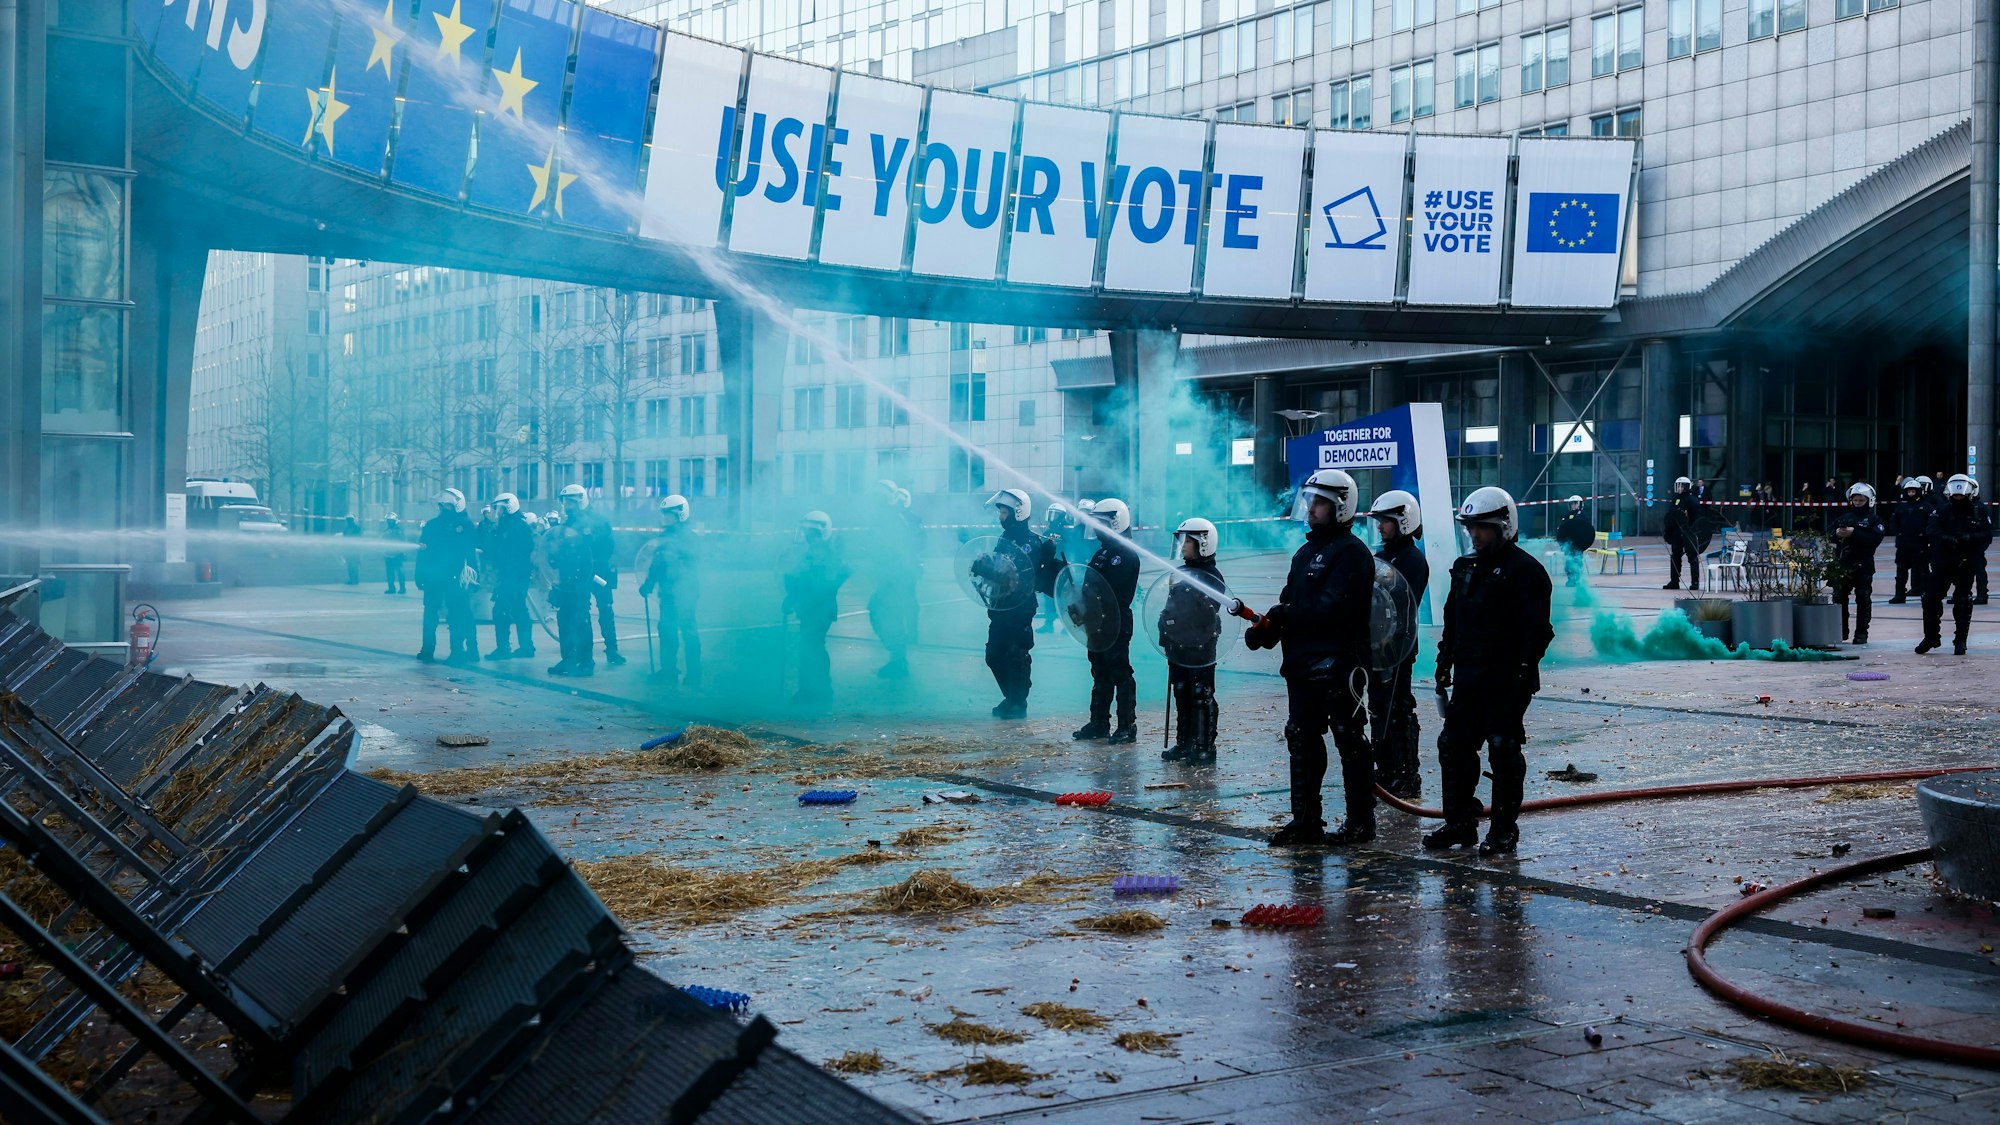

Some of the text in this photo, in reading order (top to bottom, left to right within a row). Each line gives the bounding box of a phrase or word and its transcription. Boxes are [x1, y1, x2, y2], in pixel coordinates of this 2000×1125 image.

[716, 106, 1263, 249] USE YOUR VOTE
[1424, 190, 1494, 210] #USE
[1424, 212, 1493, 232] YOUR
[1423, 233, 1491, 253] VOTE
[1324, 427, 1392, 442] TOGETHER FOR
[1324, 447, 1391, 463] DEMOCRACY
